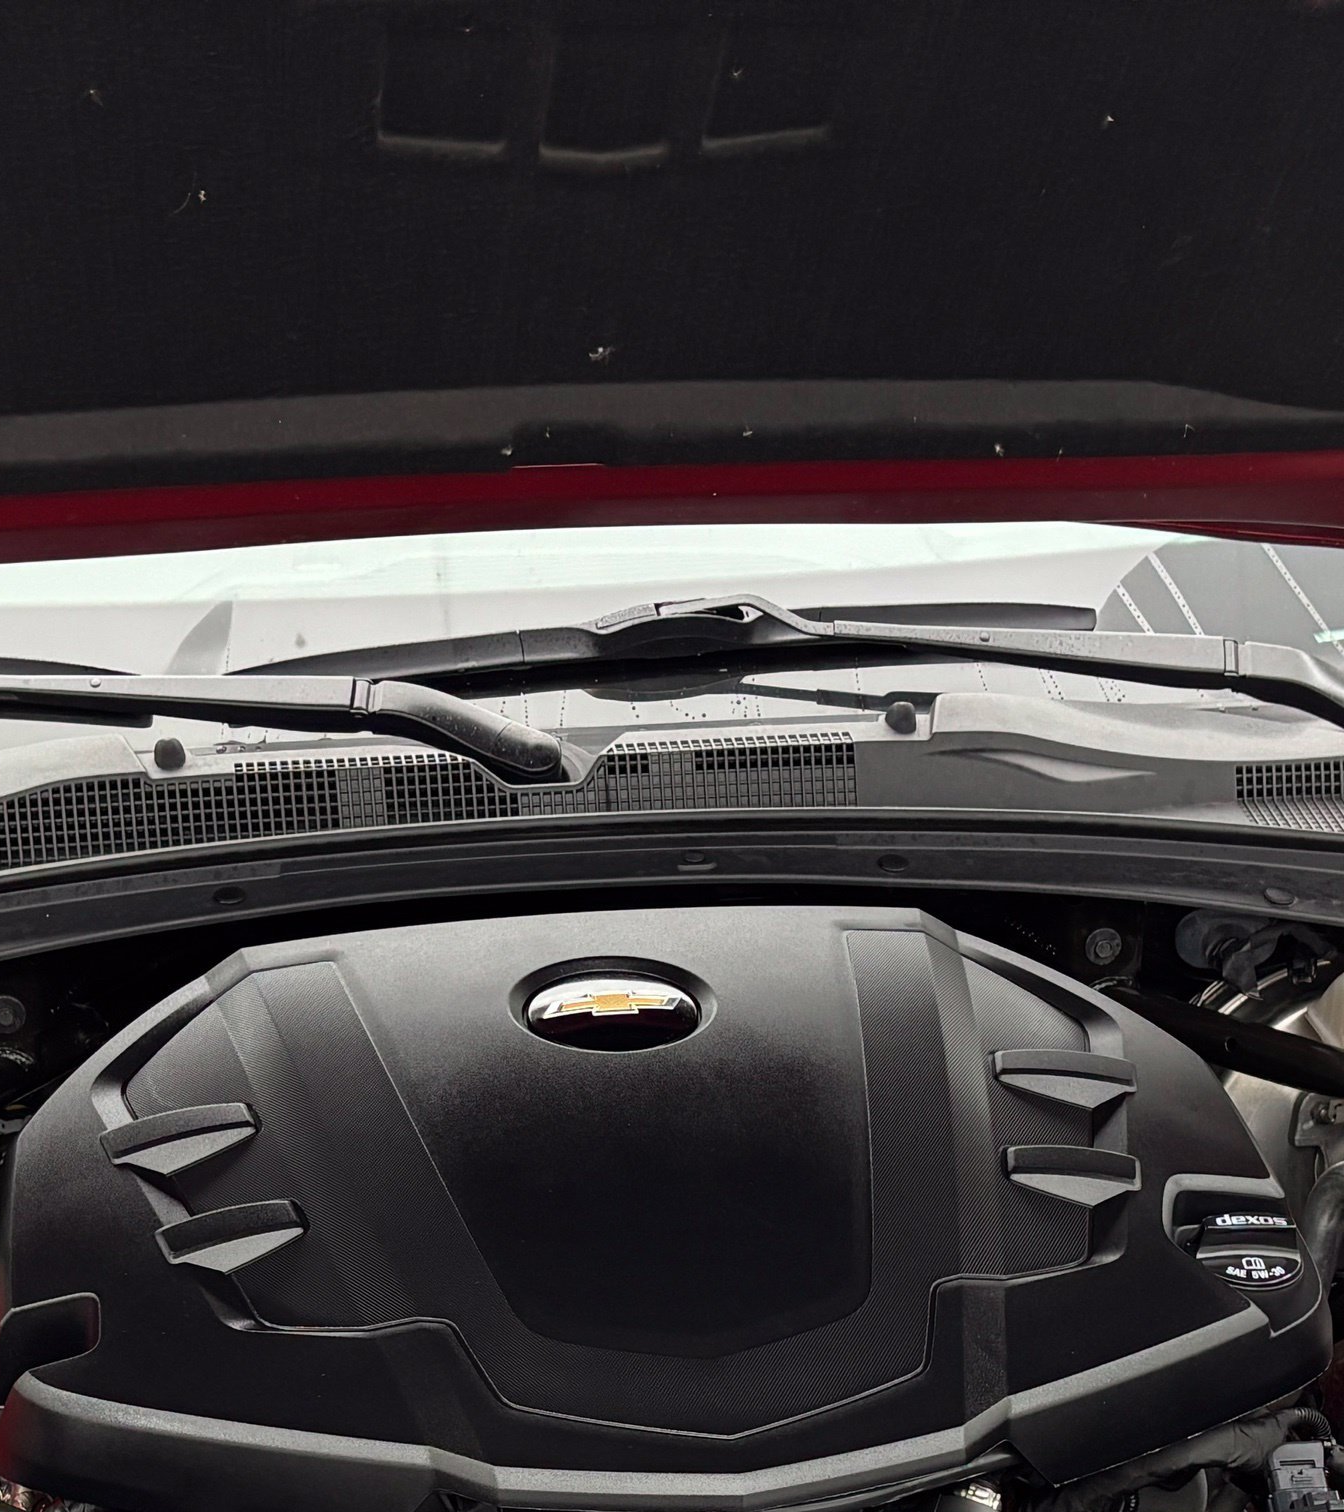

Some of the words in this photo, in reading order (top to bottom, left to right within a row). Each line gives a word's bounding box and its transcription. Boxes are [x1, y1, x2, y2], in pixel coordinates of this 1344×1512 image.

[1216, 1214, 1288, 1226] dexos
[1226, 1266, 1247, 1278] SAE
[1252, 1266, 1286, 1279] 5W-30
